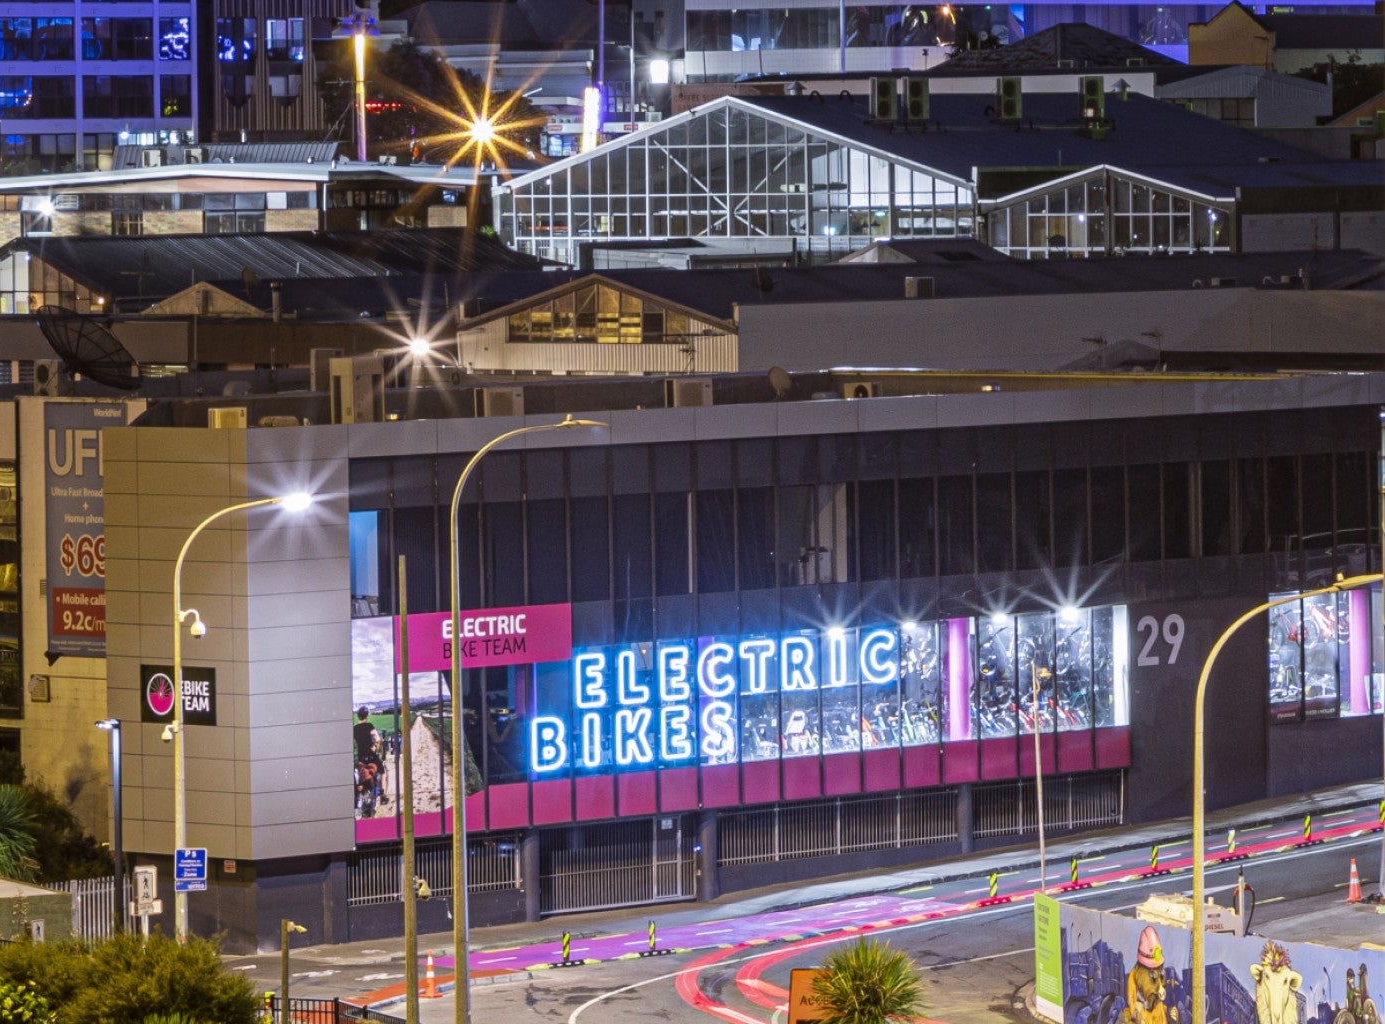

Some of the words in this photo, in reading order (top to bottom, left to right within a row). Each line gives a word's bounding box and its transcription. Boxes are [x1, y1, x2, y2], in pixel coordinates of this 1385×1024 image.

[93, 408, 122, 418] WorldNet
[48, 428, 104, 477] UF
[51, 486, 68, 497] Ultra
[68, 487, 83, 497] Fast
[64, 513, 85, 524] Home
[62, 593, 89, 606] Mobile
[443, 640, 478, 659] BKE
[482, 636, 526, 656] TEAM
[1137, 613, 1185, 667] 29
[575, 628, 899, 709] ELECTRIC
[530, 700, 735, 773] BIKES
